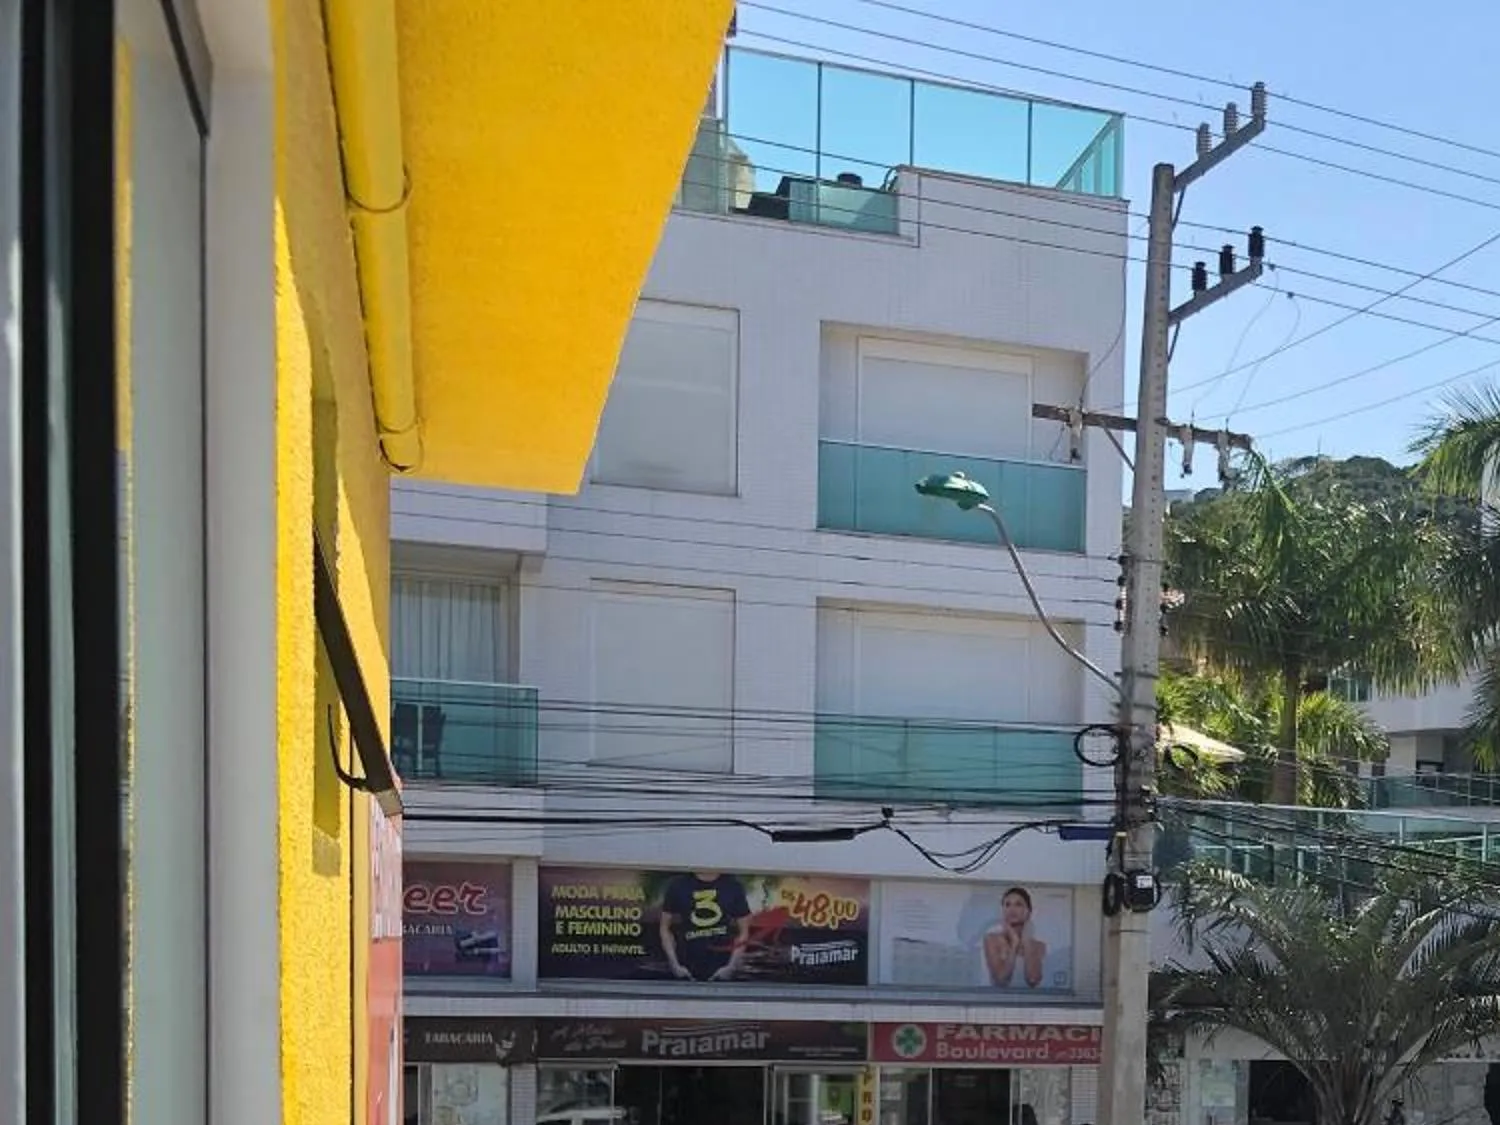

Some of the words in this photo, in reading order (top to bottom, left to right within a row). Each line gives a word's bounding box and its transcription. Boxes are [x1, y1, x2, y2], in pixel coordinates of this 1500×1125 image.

[402, 881, 488, 915] eer
[551, 884, 598, 900] MODA
[555, 904, 641, 921] MASCULINO
[555, 922, 564, 935] E
[567, 922, 641, 937] FEMININO
[641, 1028, 771, 1056] Praiamar
[936, 1042, 1049, 1061] Boulevard
